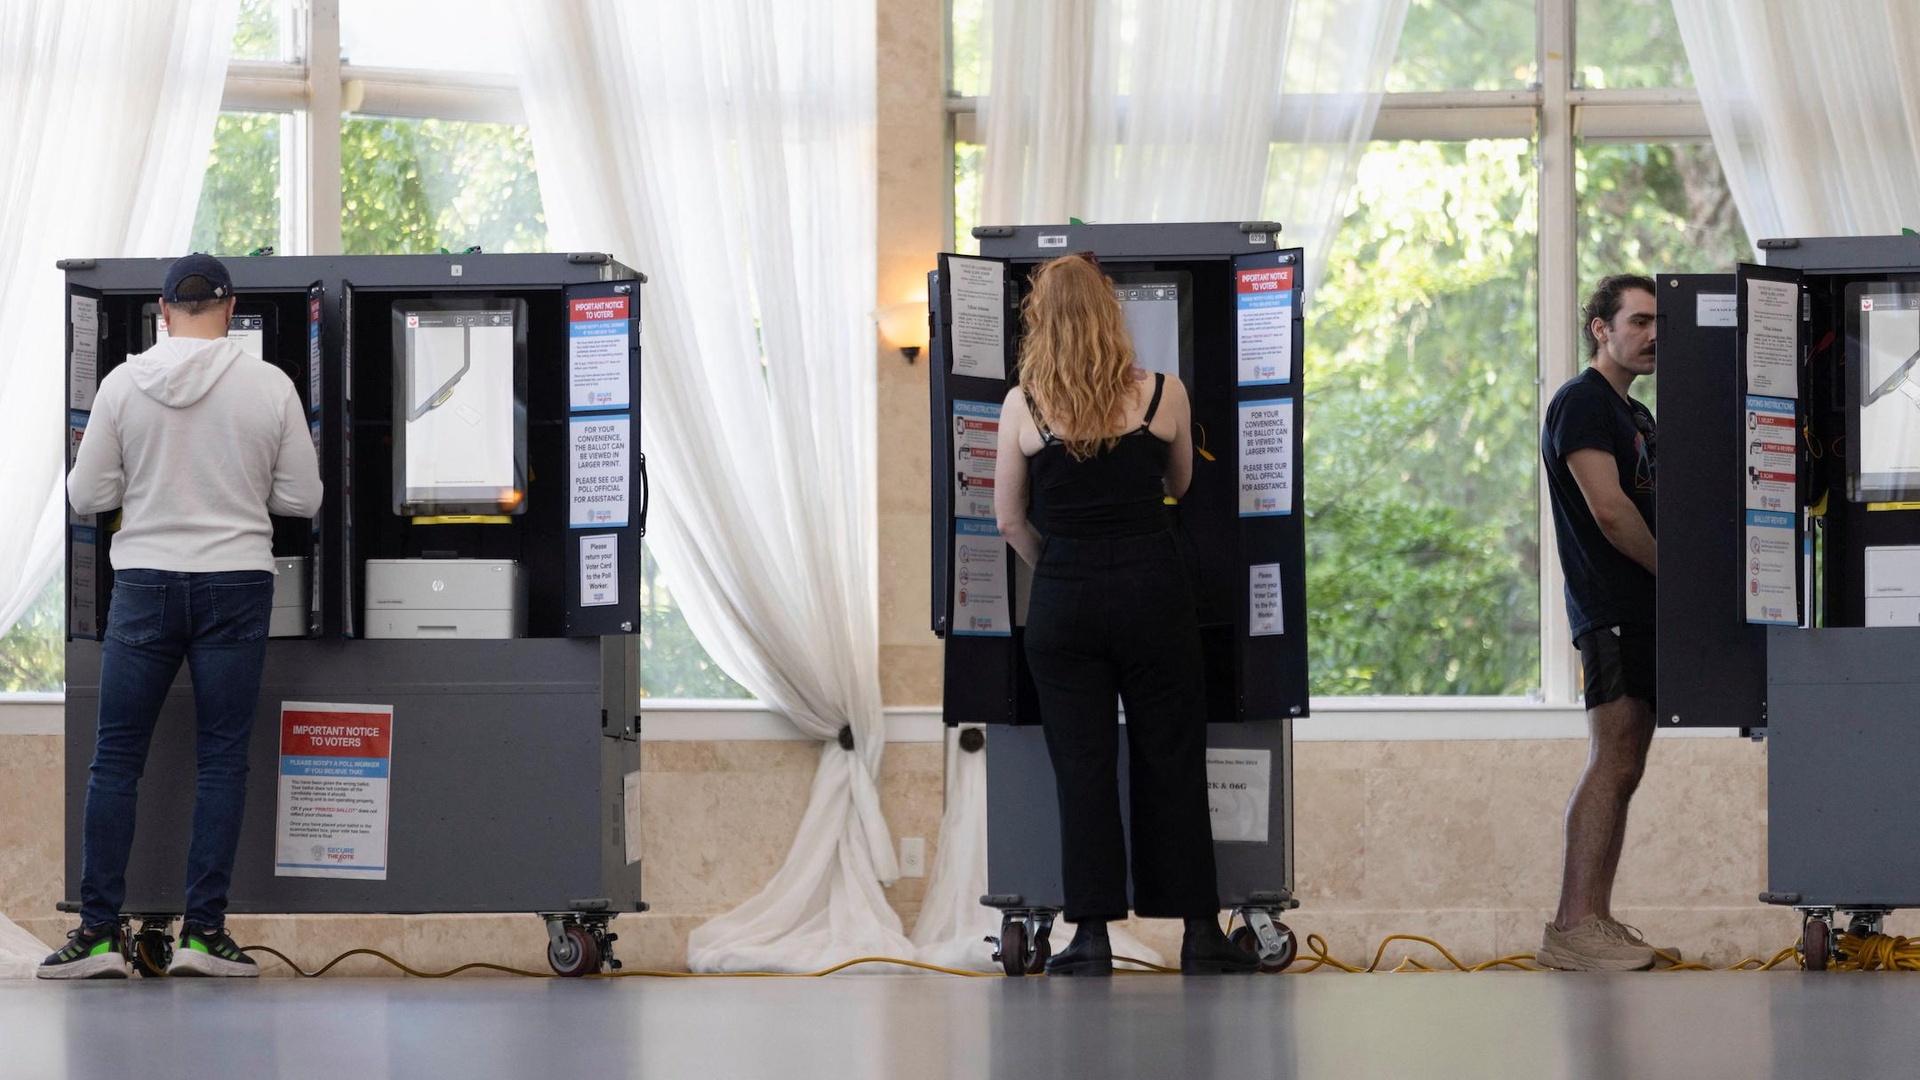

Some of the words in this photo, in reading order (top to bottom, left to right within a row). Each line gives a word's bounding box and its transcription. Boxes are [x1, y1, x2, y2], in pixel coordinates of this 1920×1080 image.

[1242, 272, 1269, 283] IMPORTANT
[1270, 271, 1288, 280] NOTICE
[1259, 282, 1278, 290] VOTERS
[575, 302, 604, 311] IMPORTANT
[605, 300, 624, 309] NOTICE
[594, 310, 614, 318] VOTERS
[578, 434, 622, 442] CONVENIENCE,
[1243, 464, 1262, 472] PLEASE
[1260, 472, 1283, 480] OFFICIAL
[586, 495, 624, 503] ASSISTANCE.
[601, 553, 612, 561] your
[293, 725, 344, 736] IMPORTANT
[346, 727, 380, 736] NOTICE
[311, 737, 323, 746] TO
[325, 737, 361, 747] VOTERS
